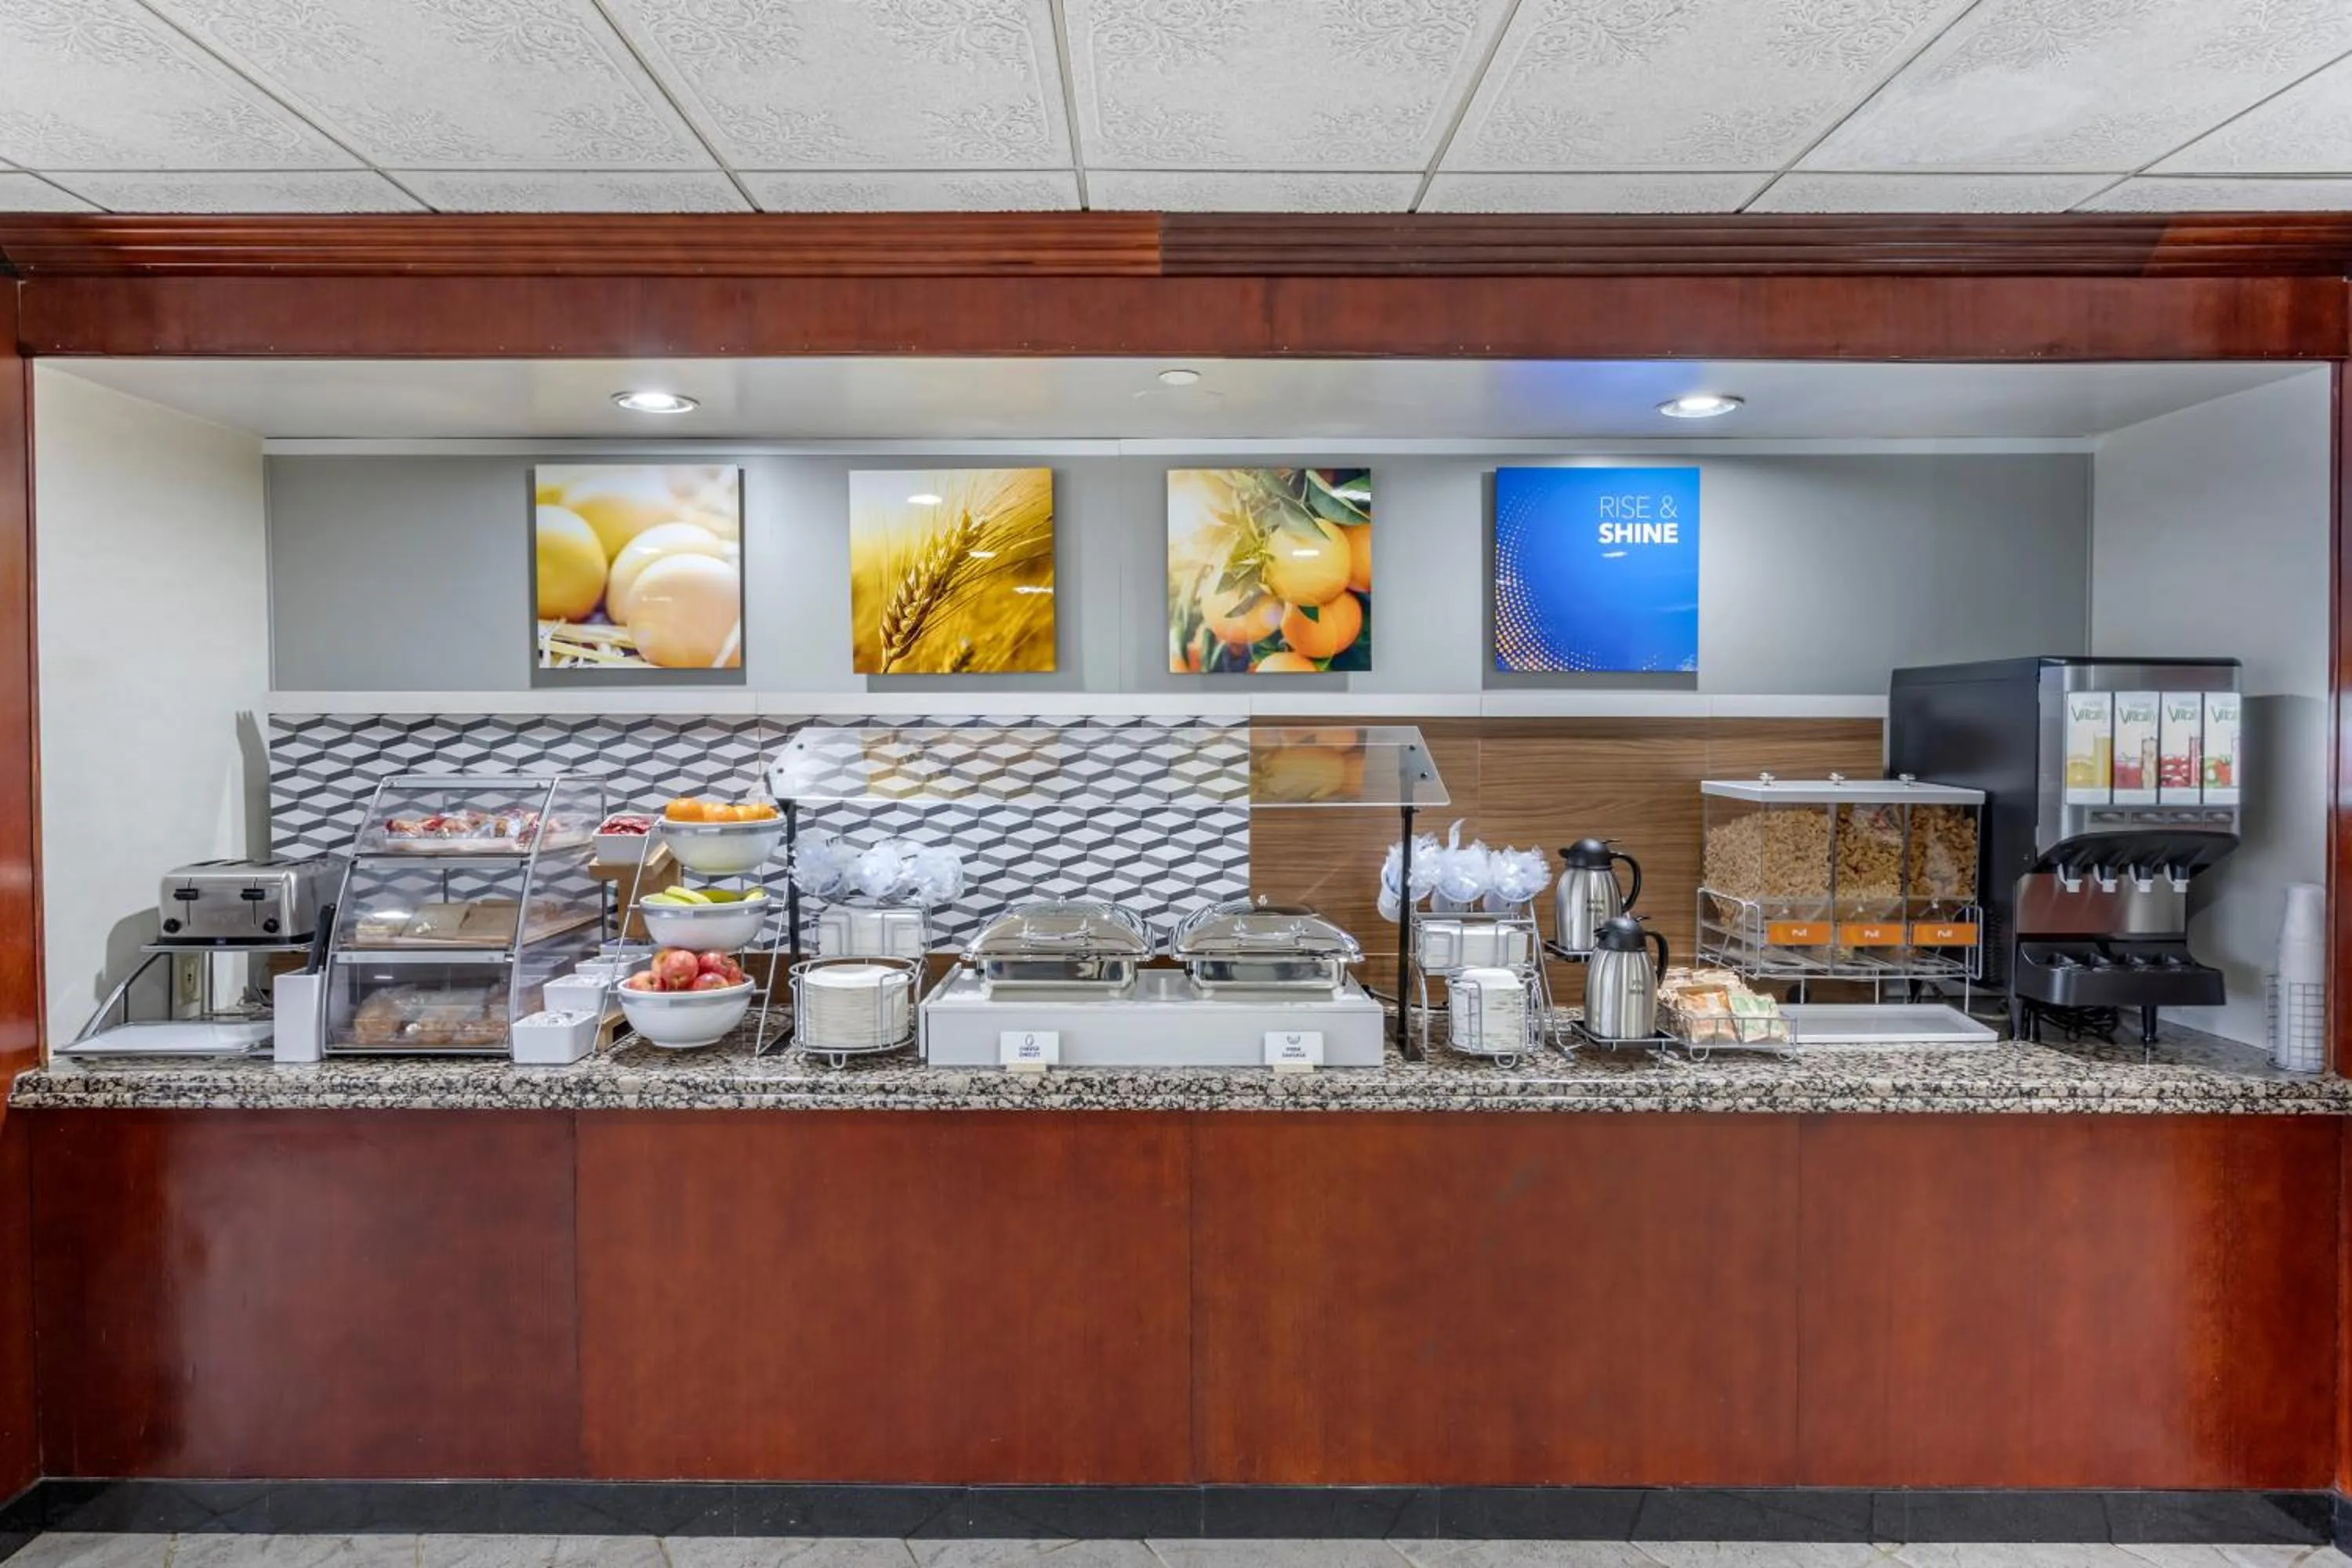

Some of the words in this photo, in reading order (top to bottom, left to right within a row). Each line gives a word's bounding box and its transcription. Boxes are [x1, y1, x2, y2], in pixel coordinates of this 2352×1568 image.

[1599, 495, 1650, 518] RISE
[1660, 495, 1679, 518] &
[1599, 522, 1679, 544] SHINE
